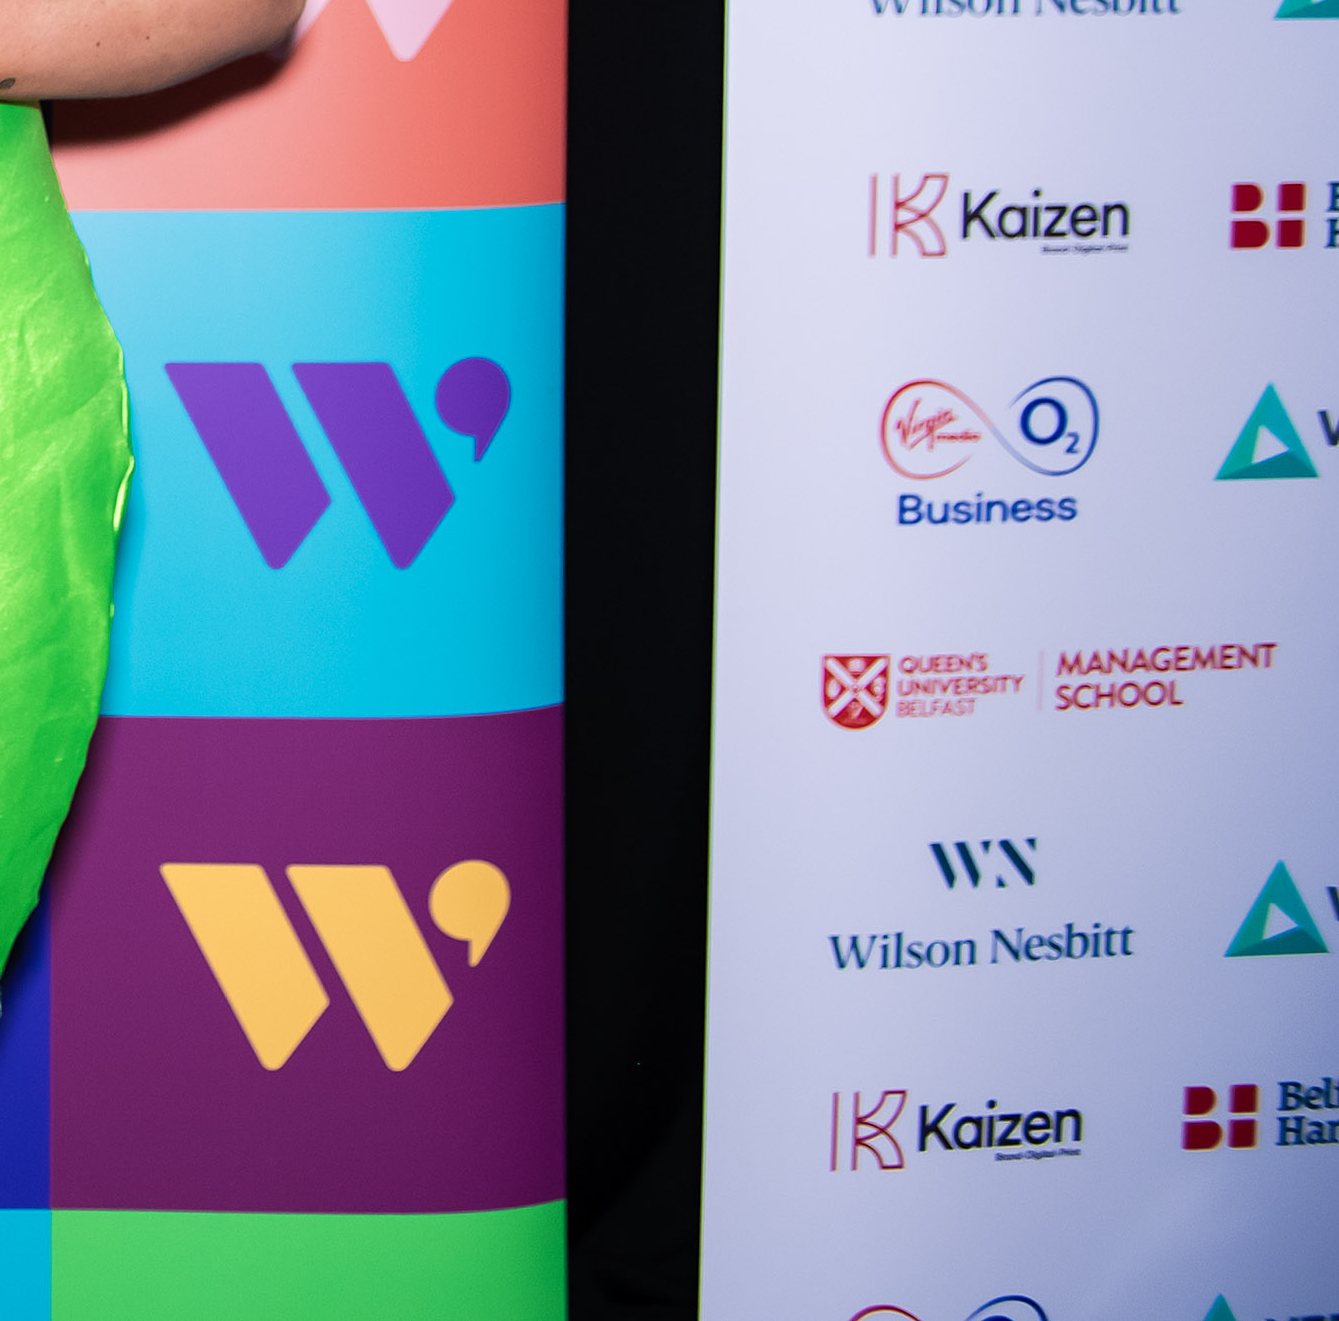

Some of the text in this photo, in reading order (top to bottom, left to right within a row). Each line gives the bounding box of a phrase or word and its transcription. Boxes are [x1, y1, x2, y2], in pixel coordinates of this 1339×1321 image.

[962, 190, 1129, 239] Kaizen
[898, 493, 1078, 525] Business
[1057, 642, 1278, 676] MANAGEMENT
[1056, 680, 1184, 710] SCHOOL
[829, 923, 1134, 969] Wilson Nesbitt
[1277, 1077, 1339, 1111] Bel
[918, 1100, 1082, 1156] Kaizen
[1276, 1116, 1339, 1146] Har
